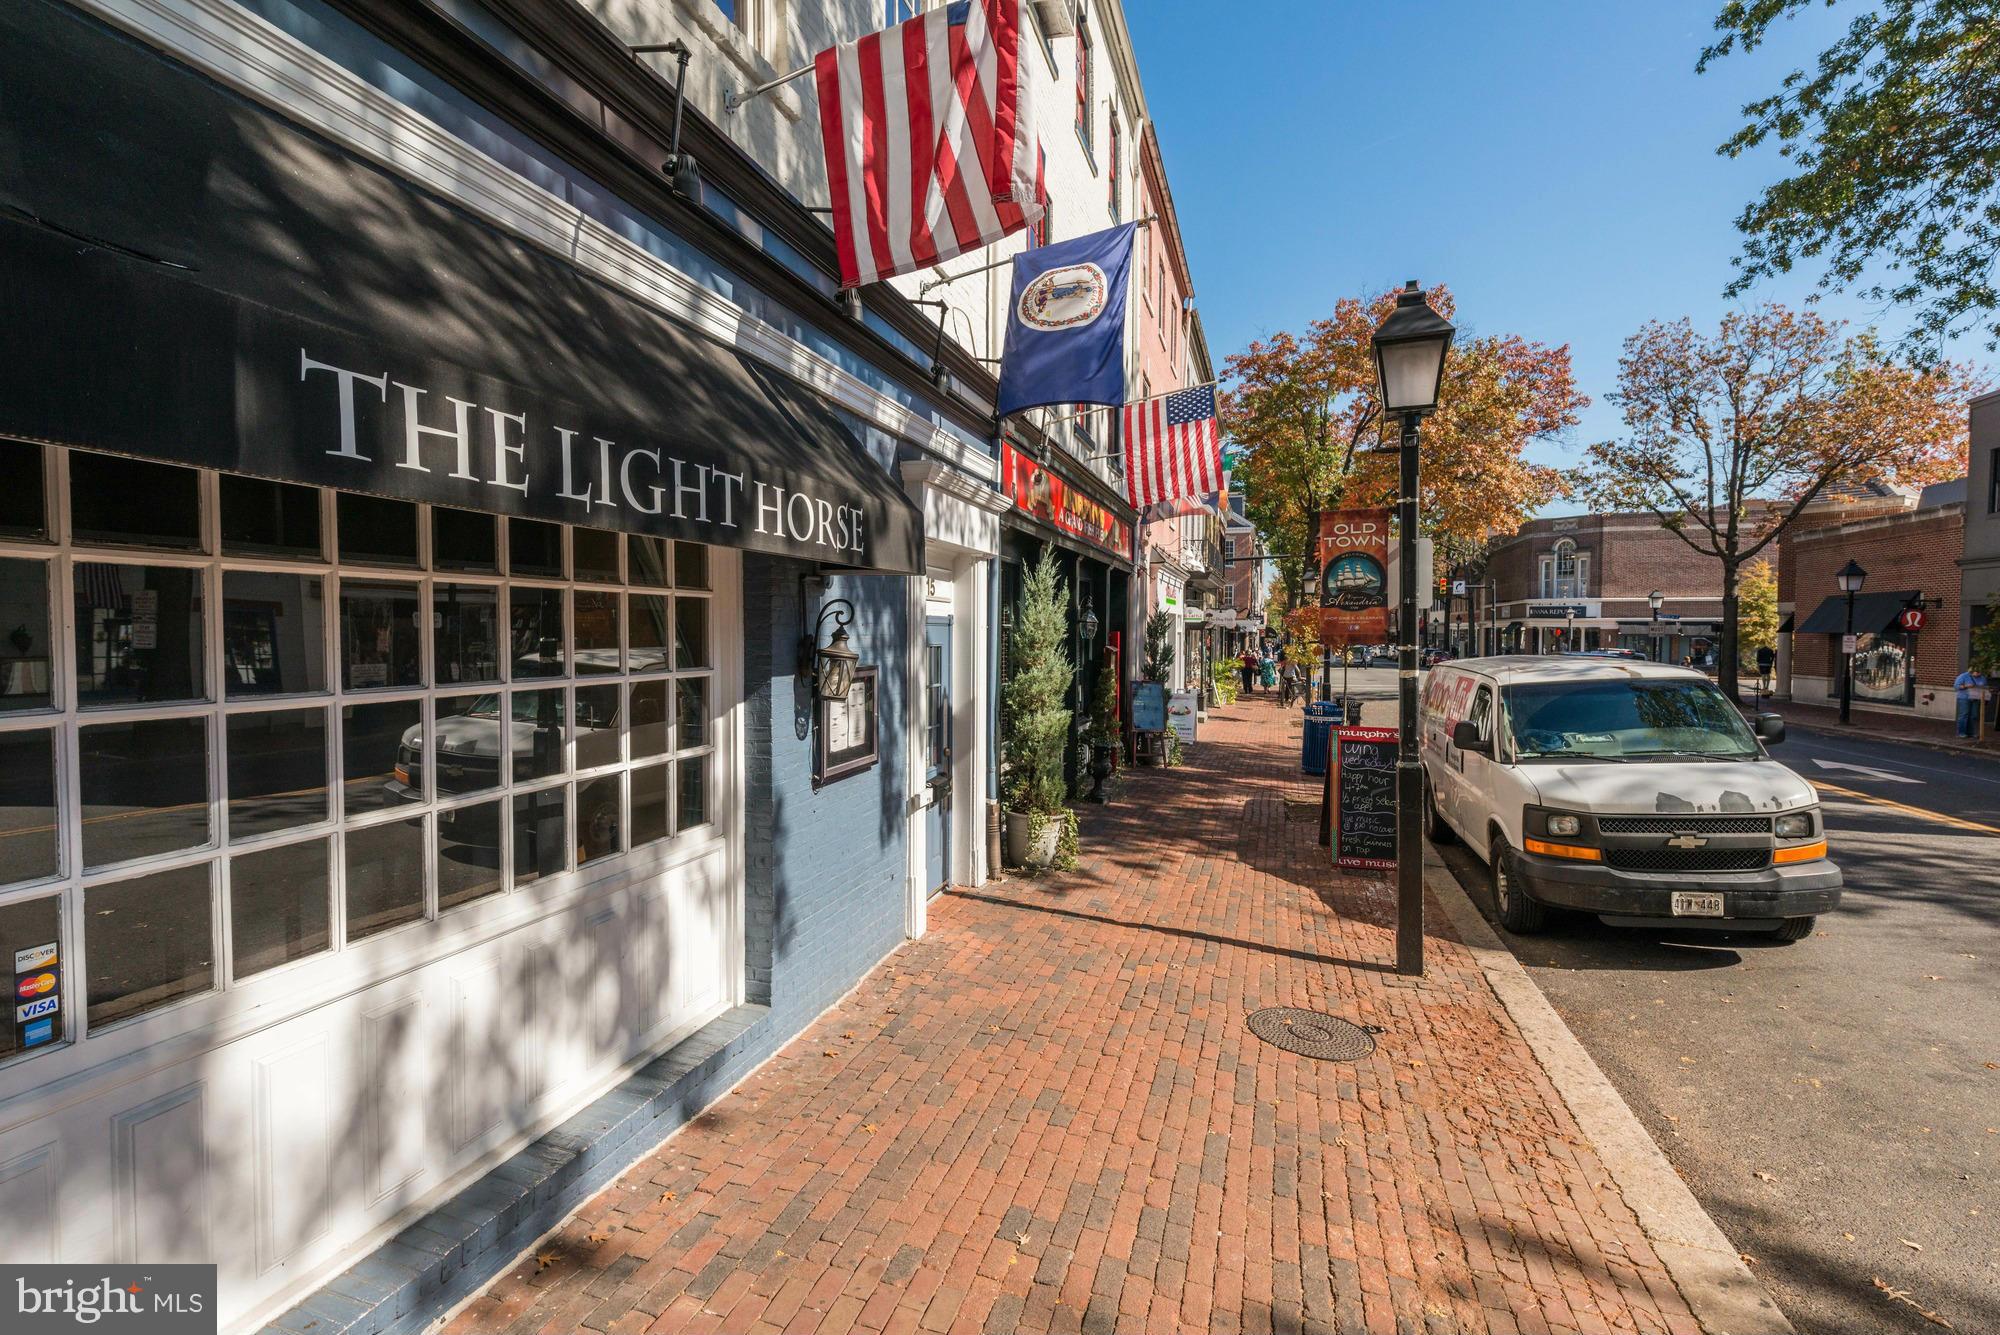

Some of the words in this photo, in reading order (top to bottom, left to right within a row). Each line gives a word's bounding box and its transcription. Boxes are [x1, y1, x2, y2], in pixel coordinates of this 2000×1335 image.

[300, 347, 530, 498] THE
[553, 425, 744, 529] LIGHT
[753, 480, 866, 557] HORSE
[1333, 523, 1377, 535] OLD
[1324, 535, 1386, 548] TOWN
[18, 948, 55, 962] DISCOVER
[22, 999, 57, 1018] VISA
